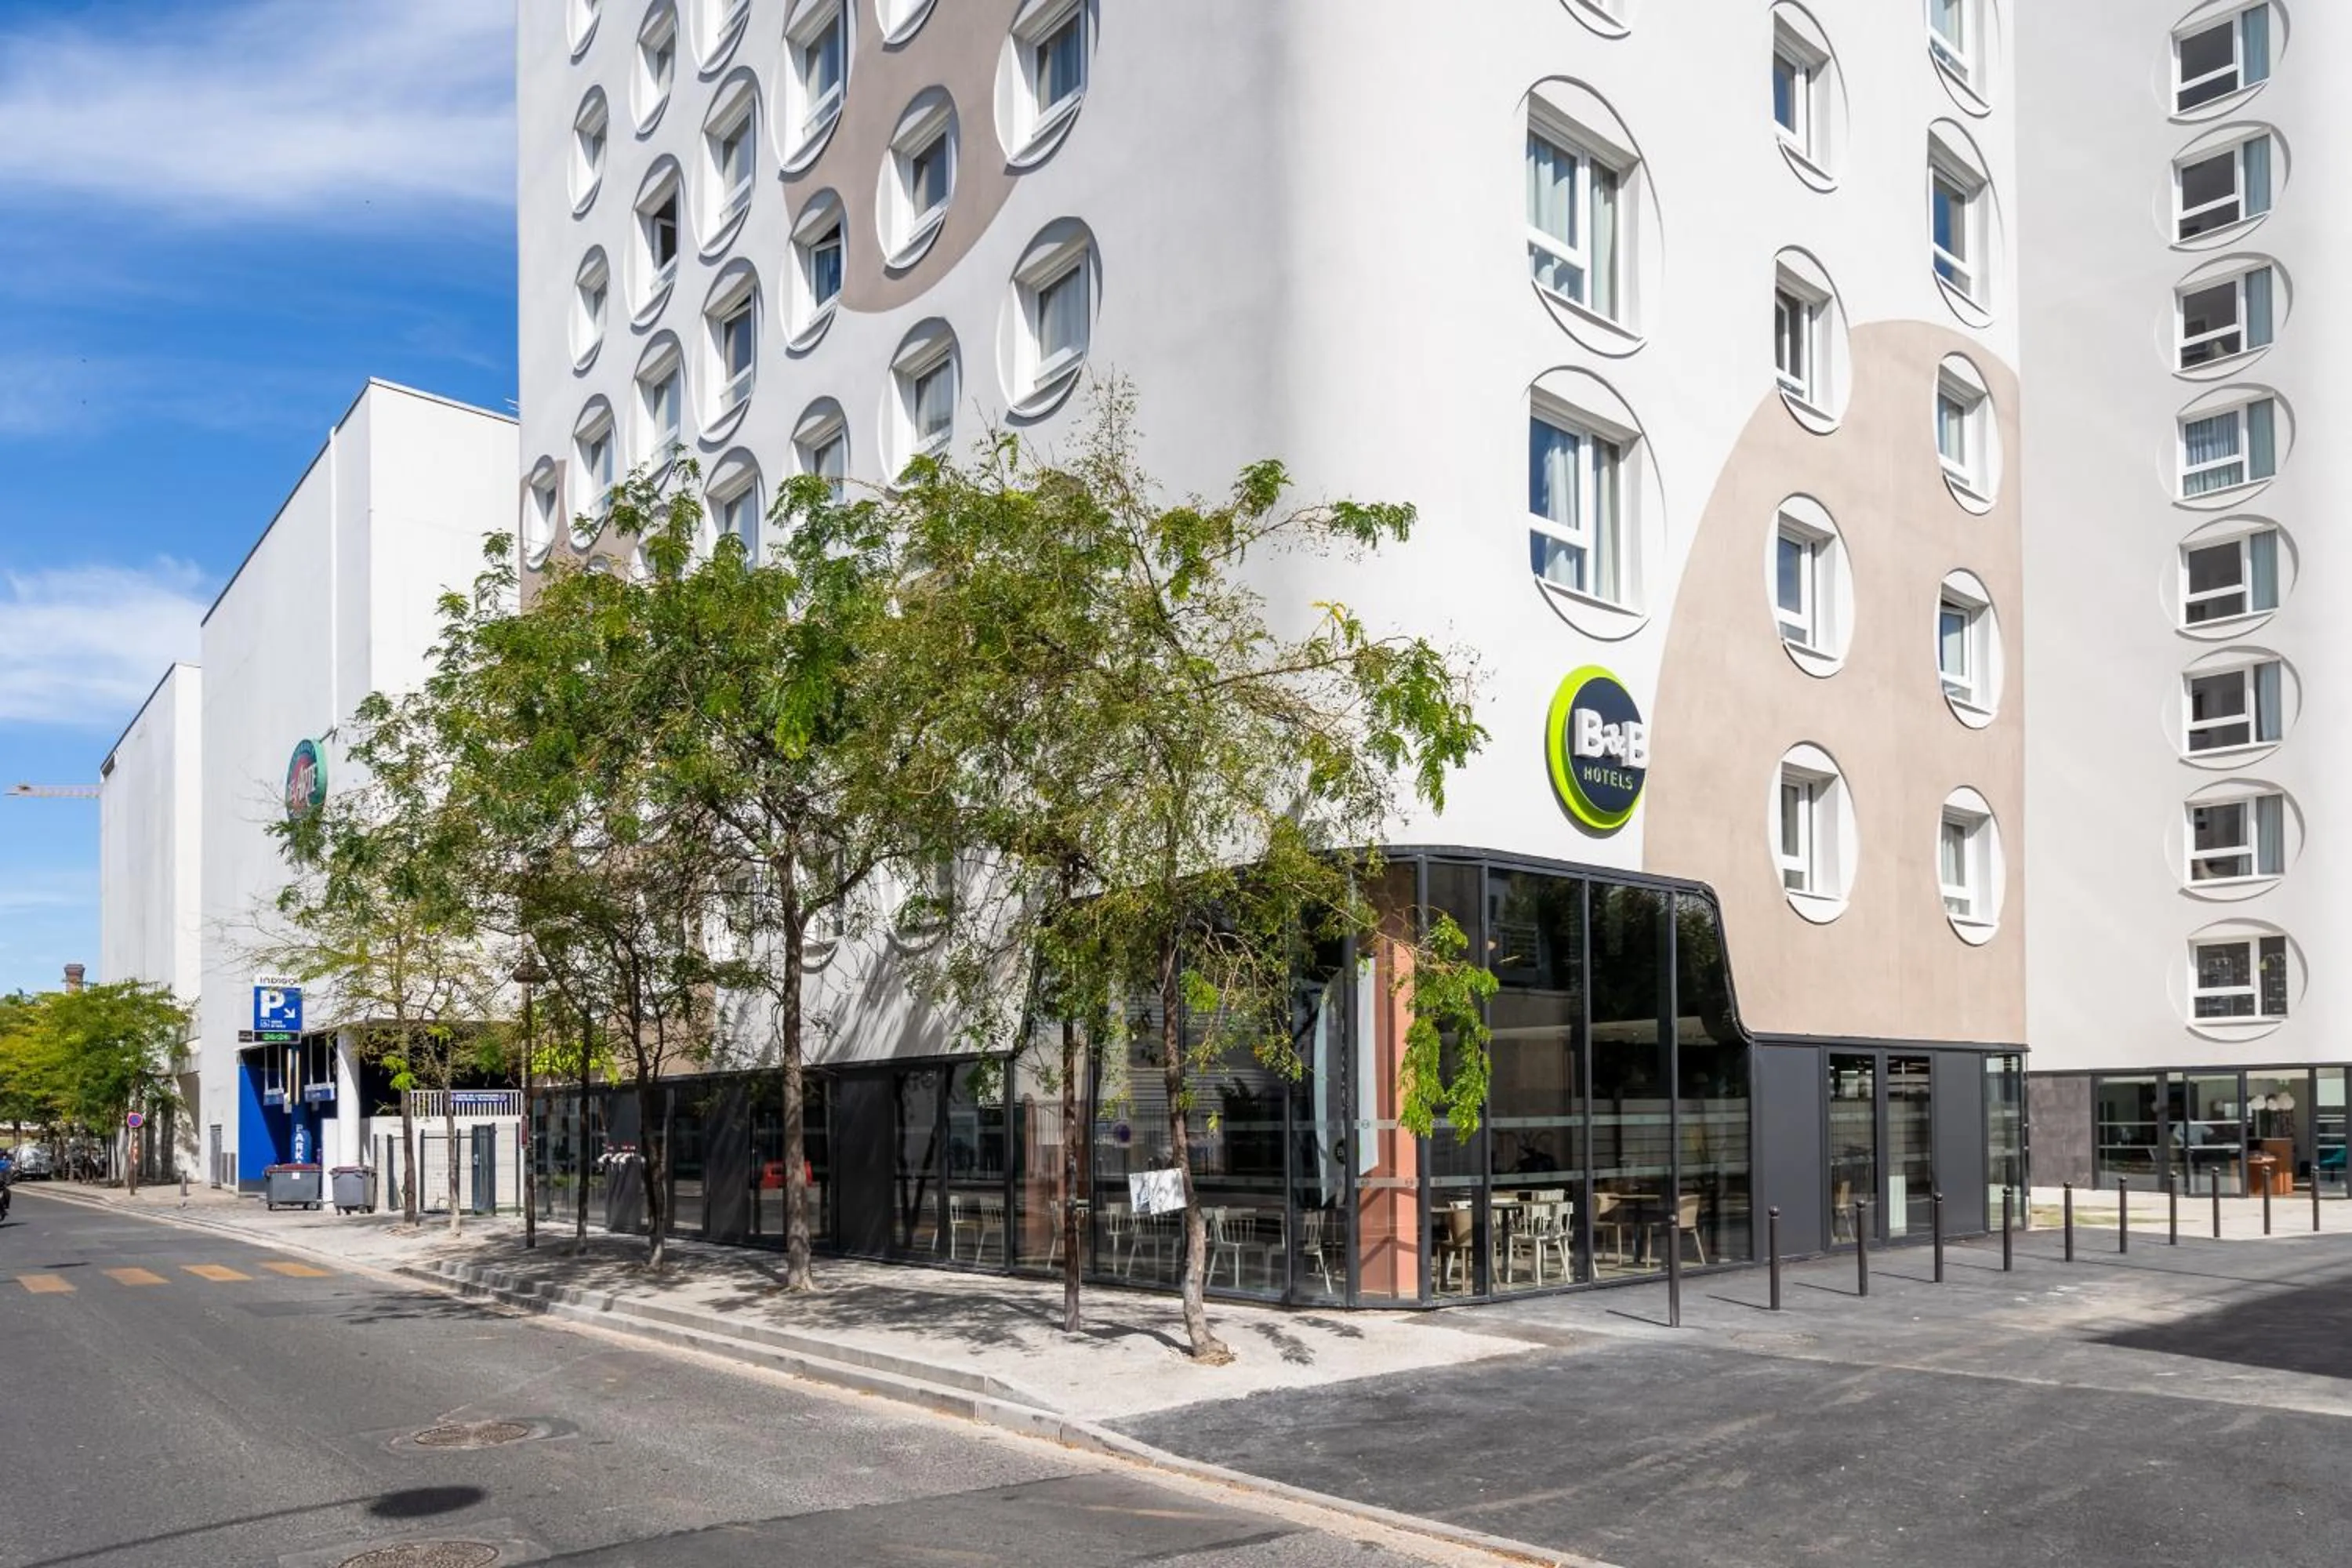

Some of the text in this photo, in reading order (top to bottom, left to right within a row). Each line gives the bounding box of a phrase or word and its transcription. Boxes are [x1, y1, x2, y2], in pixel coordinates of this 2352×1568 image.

[1573, 708, 1650, 769] B&B
[1584, 765, 1633, 790] HOTELS
[260, 989, 285, 1018] P
